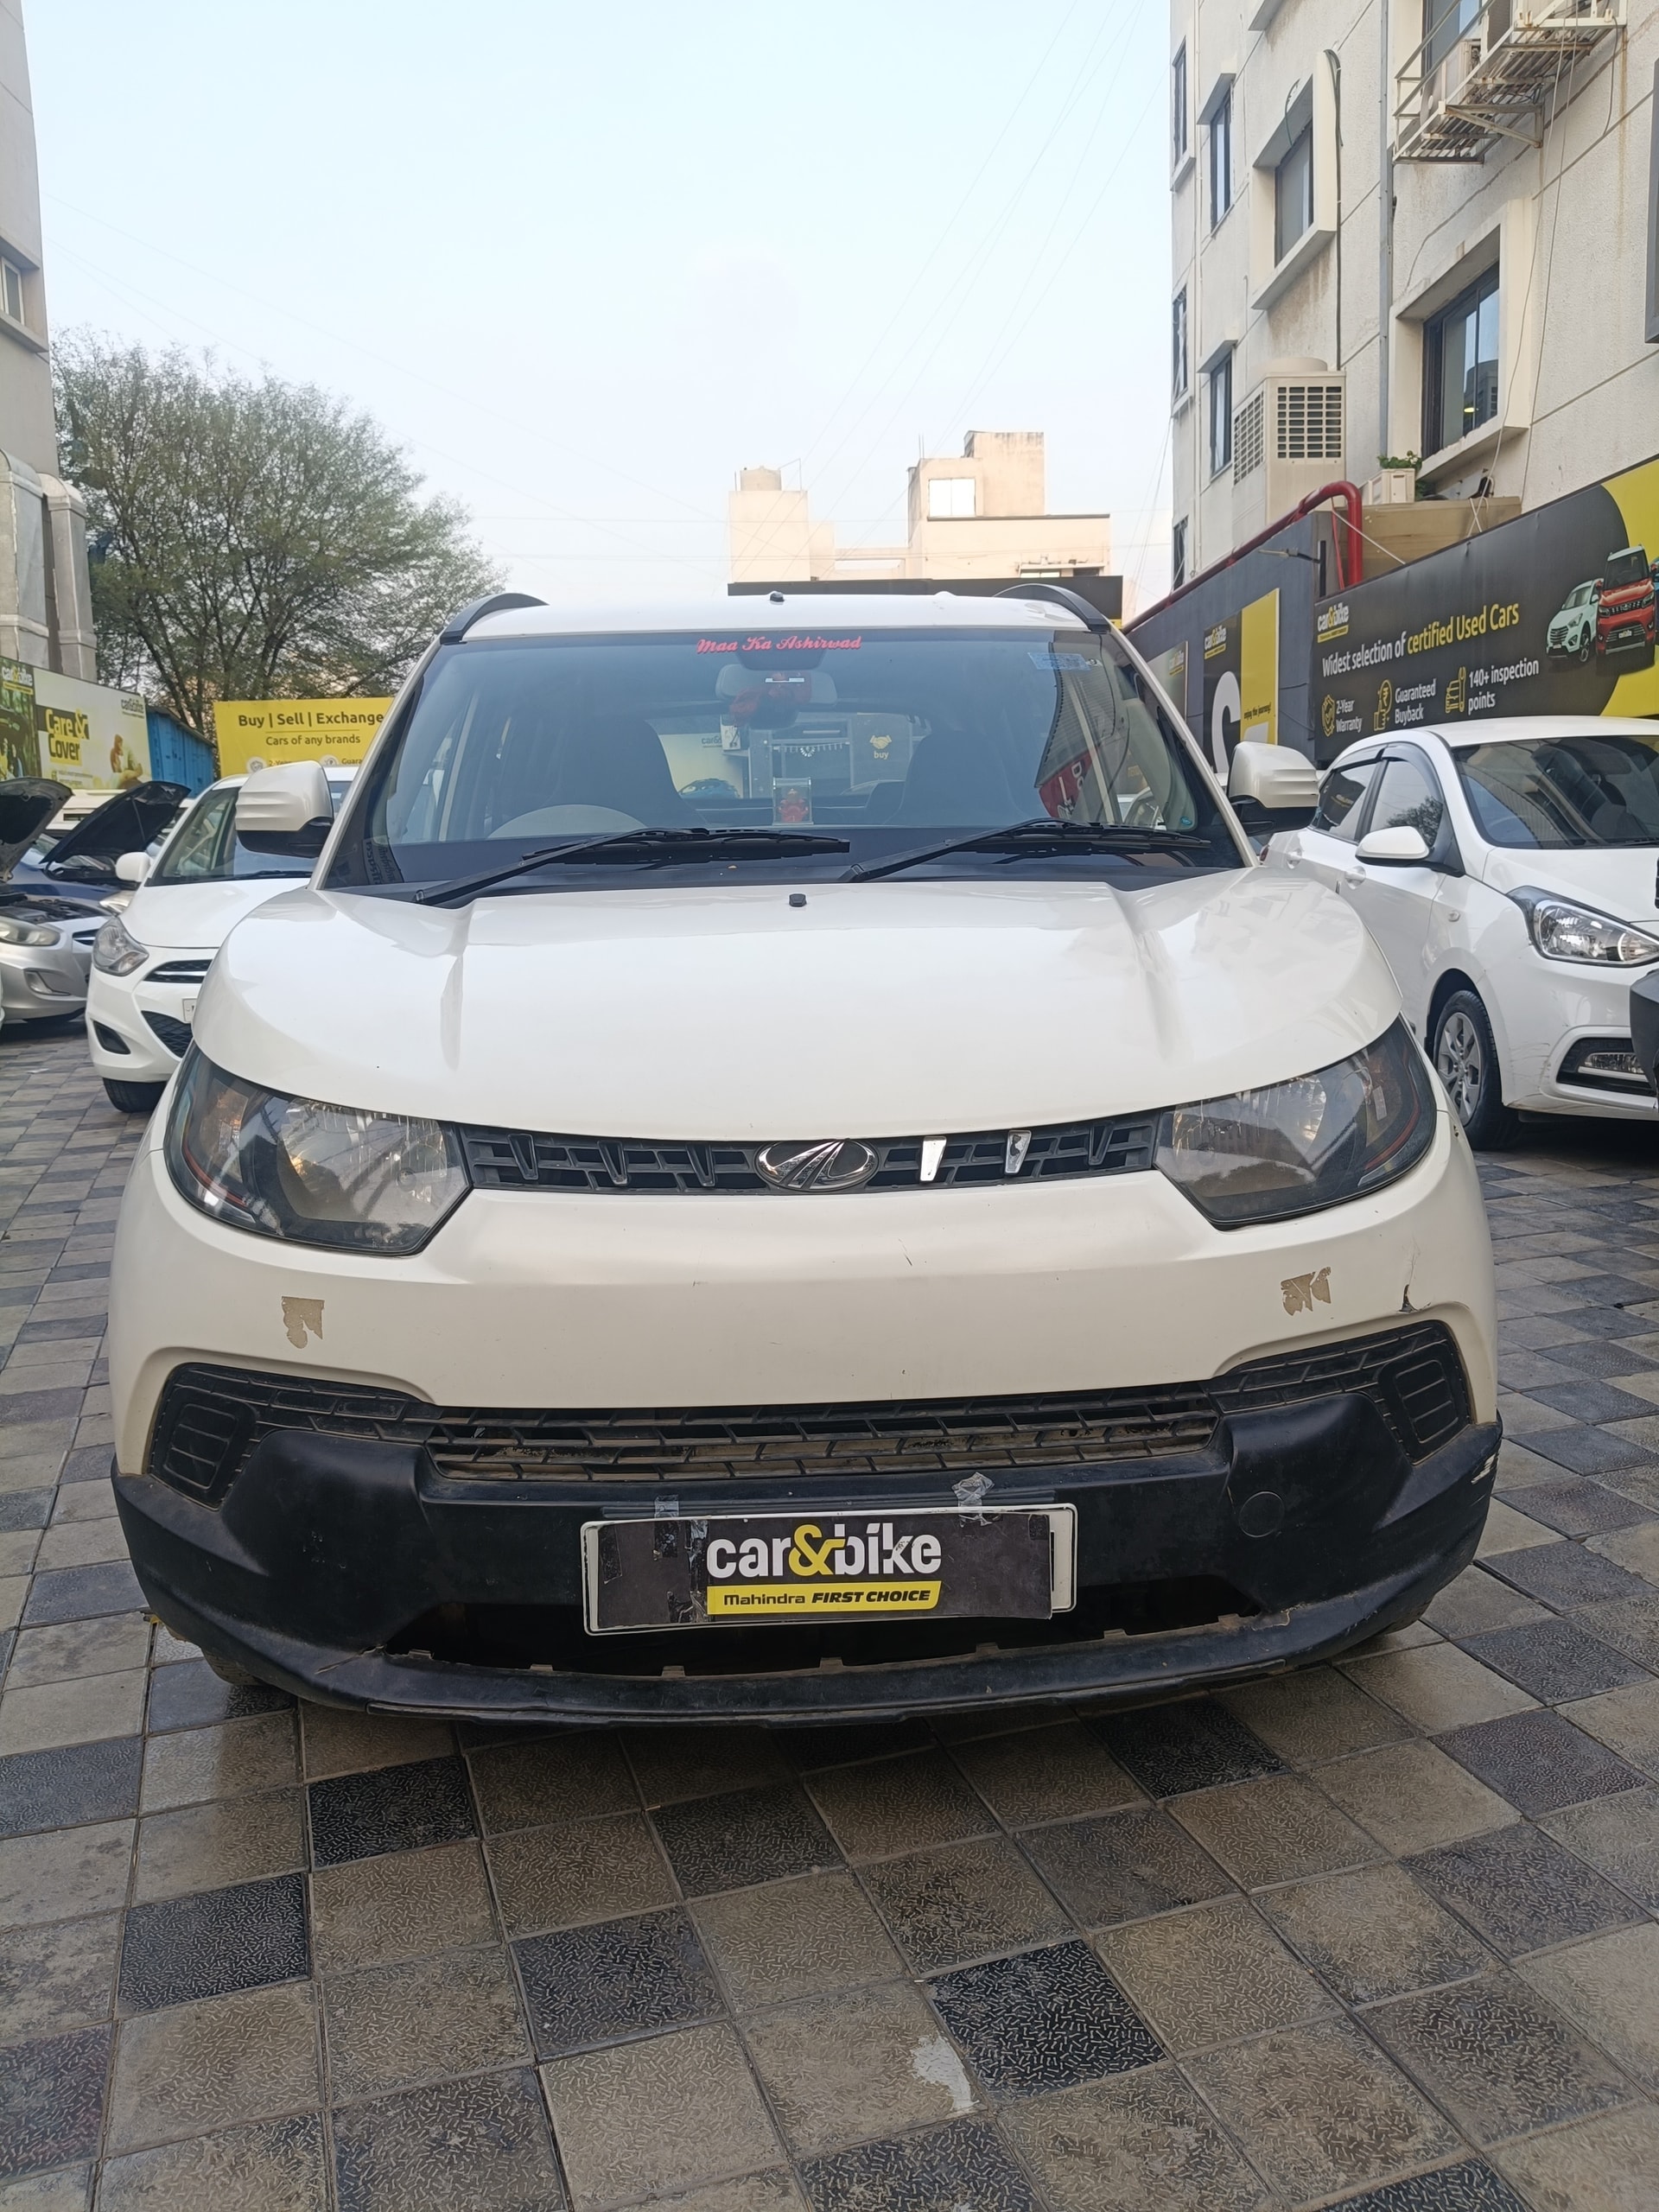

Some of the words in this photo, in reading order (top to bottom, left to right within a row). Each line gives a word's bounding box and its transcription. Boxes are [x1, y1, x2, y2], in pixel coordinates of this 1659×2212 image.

[1318, 602, 1350, 632] car&bike
[696, 639, 738, 654] Maa
[741, 636, 772, 651] Ka
[776, 635, 862, 650] Ashirwad
[1322, 652, 1351, 677] Widest
[1351, 639, 1393, 671] selection
[1395, 631, 1407, 658] of
[1408, 616, 1453, 655] certified
[1456, 606, 1487, 641] Used
[1490, 603, 1520, 631] Cars
[1469, 671, 1490, 689] 140+
[1491, 658, 1539, 685] inspection
[1395, 678, 1436, 703] Guaranteed
[1336, 699, 1354, 714] 2-Year
[1469, 692, 1496, 715] points
[45, 708, 73, 736] Care
[238, 715, 264, 728] Buy
[276, 712, 304, 726] Sell
[316, 711, 385, 726] Exchange
[1336, 716, 1363, 734] Warranty
[1395, 704, 1424, 726] Buyback
[48, 733, 80, 760] Cover
[265, 736, 289, 746] Cars
[290, 735, 302, 745] of
[304, 736, 322, 747] any
[325, 734, 361, 744] brands
[874, 750, 889, 760] buy
[706, 1522, 942, 1579] car&bike
[723, 1592, 806, 1606] Mahindra
[810, 1591, 865, 1605] FIRST
[865, 1588, 931, 1603] CHOICE
